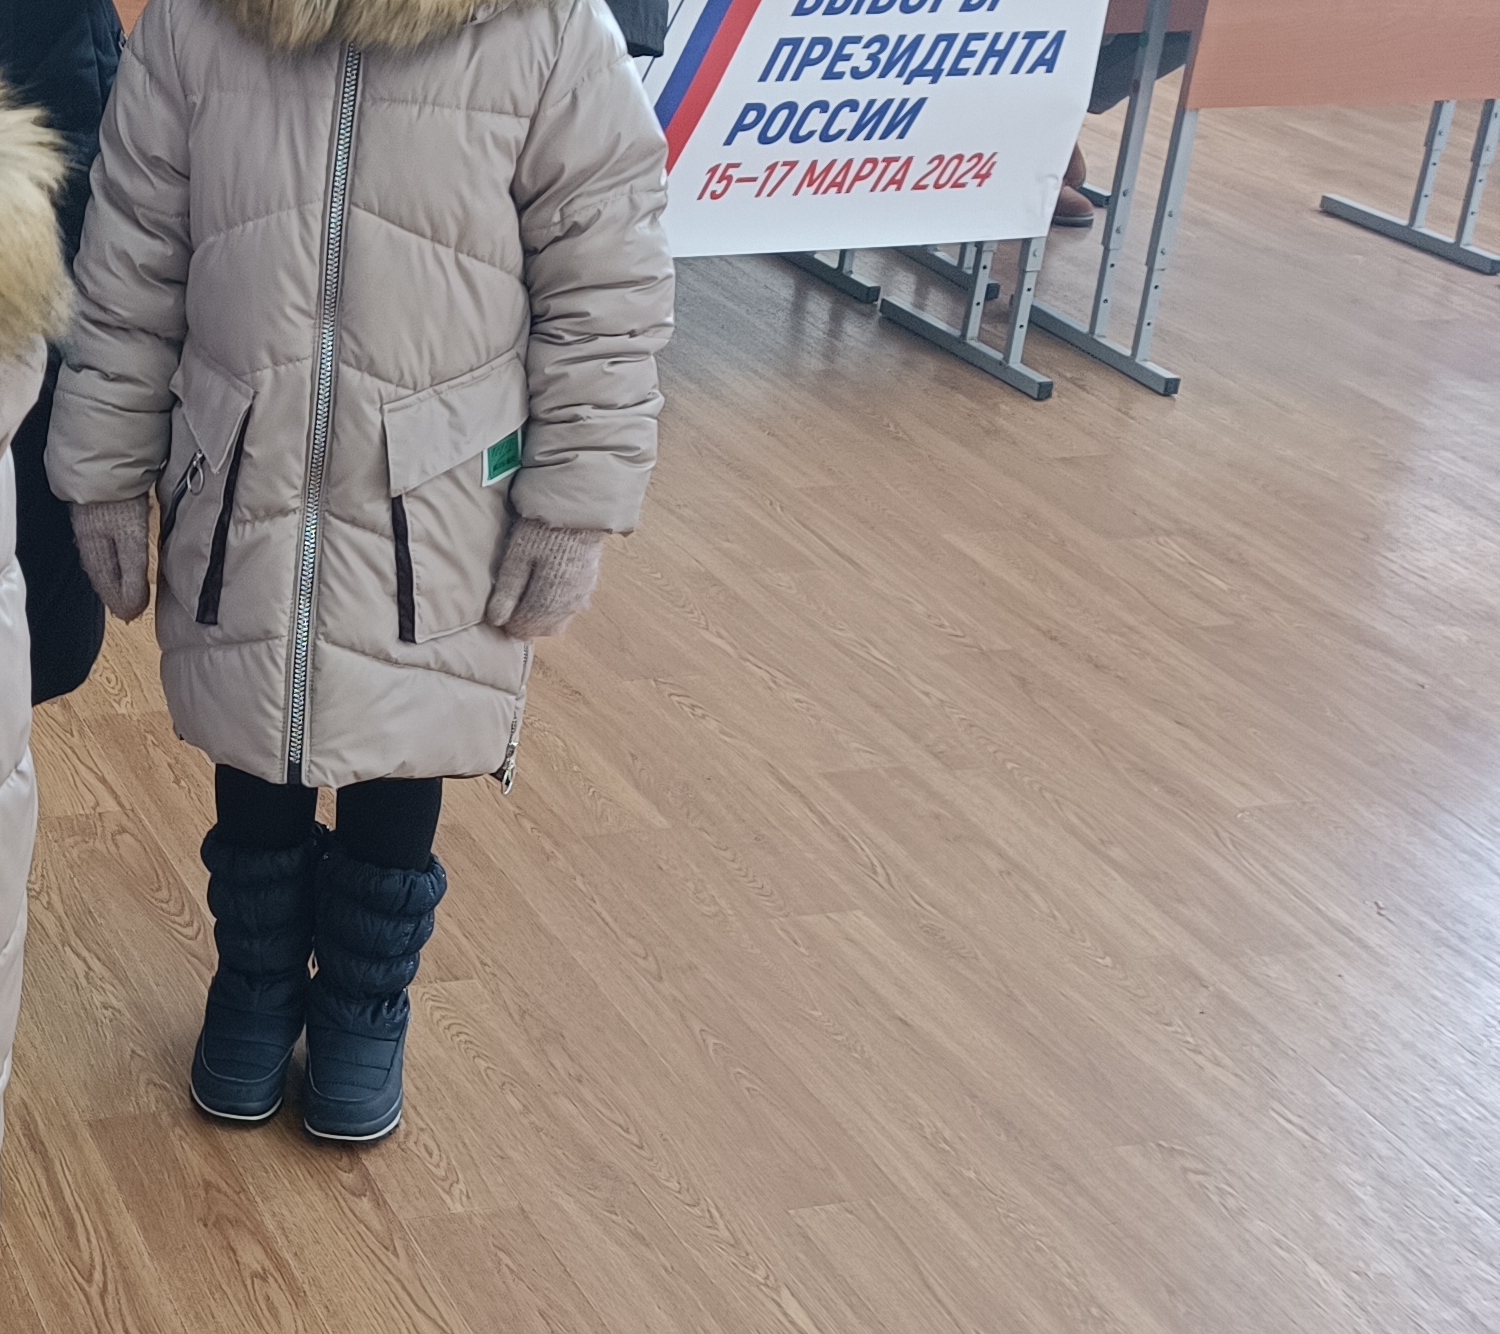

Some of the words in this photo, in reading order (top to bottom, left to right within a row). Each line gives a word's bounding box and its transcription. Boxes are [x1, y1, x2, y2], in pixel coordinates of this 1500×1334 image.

[757, 29, 1067, 86] ПРЕЗИДЕНТА
[723, 97, 928, 147] РОССИИ
[793, 155, 915, 196] МАРТА
[911, 151, 999, 192] 2024
